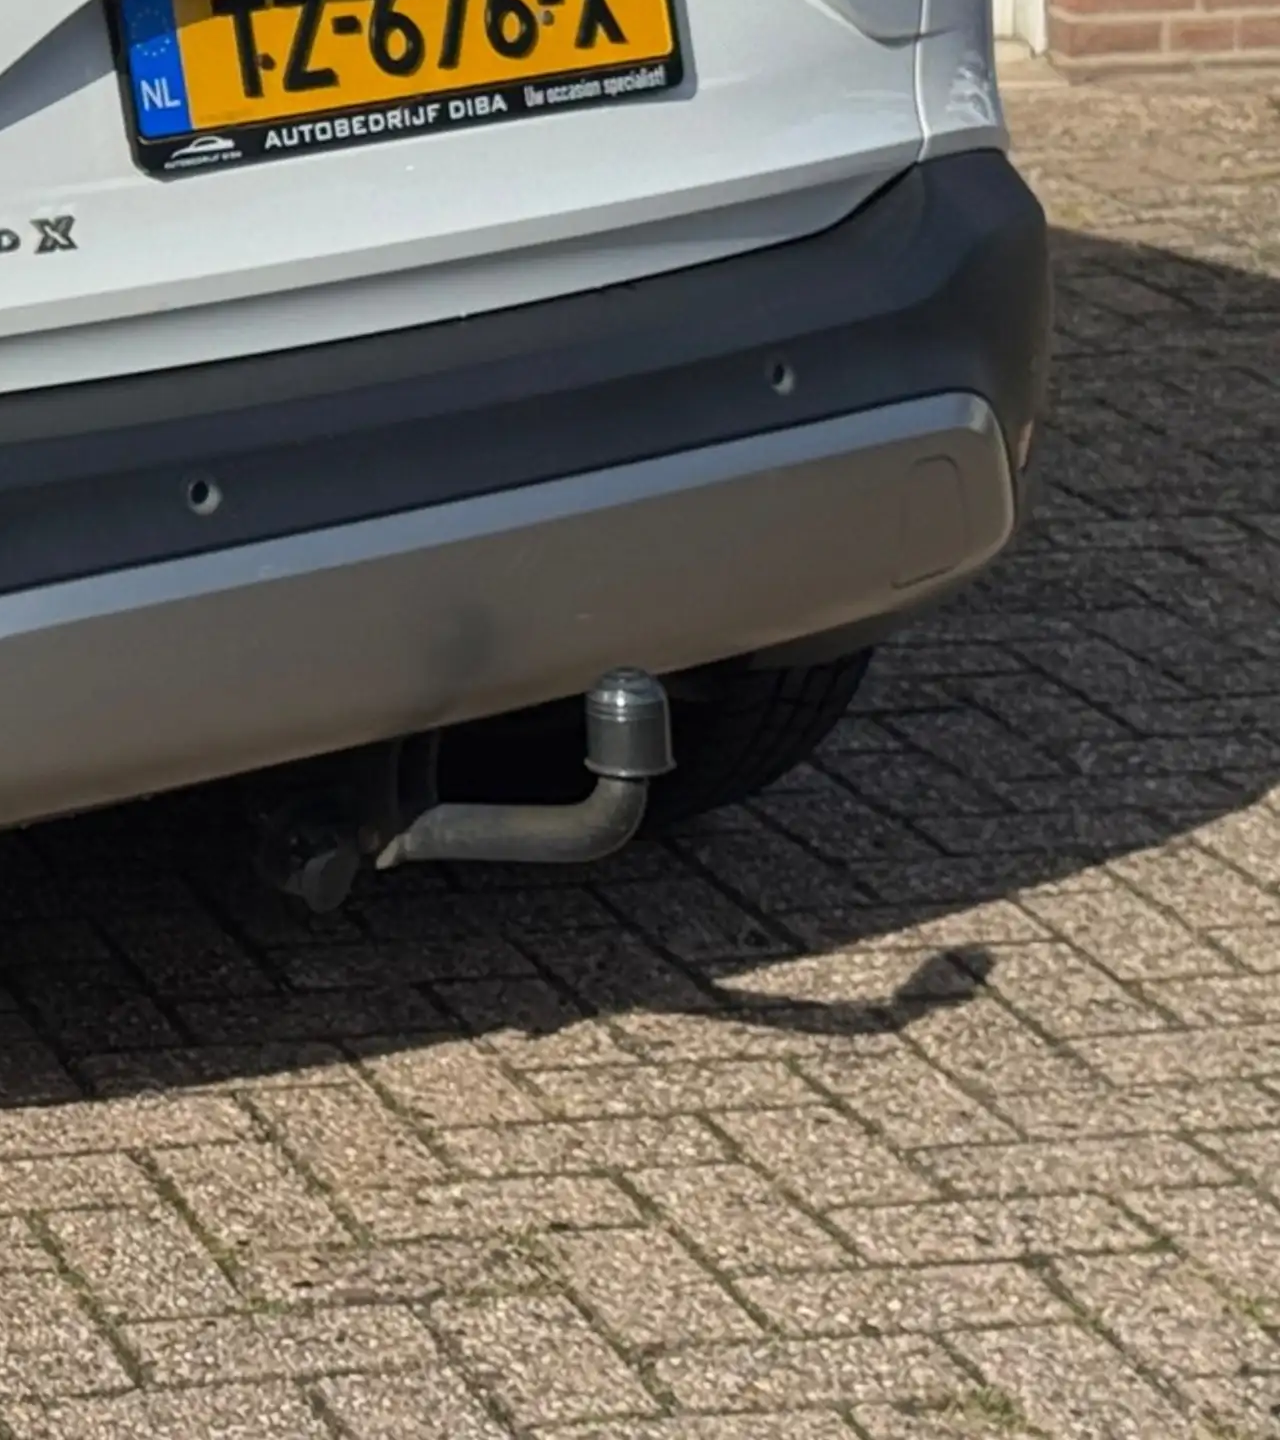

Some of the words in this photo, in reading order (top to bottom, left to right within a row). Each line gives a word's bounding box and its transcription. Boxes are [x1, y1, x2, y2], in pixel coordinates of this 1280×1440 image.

[140, 76, 182, 112] NL
[263, 102, 441, 150] AUTOBEDRIJF
[448, 93, 509, 120] DIBA
[523, 84, 544, 108] Uw
[546, 78, 602, 104] occasion
[29, 214, 79, 256] X
